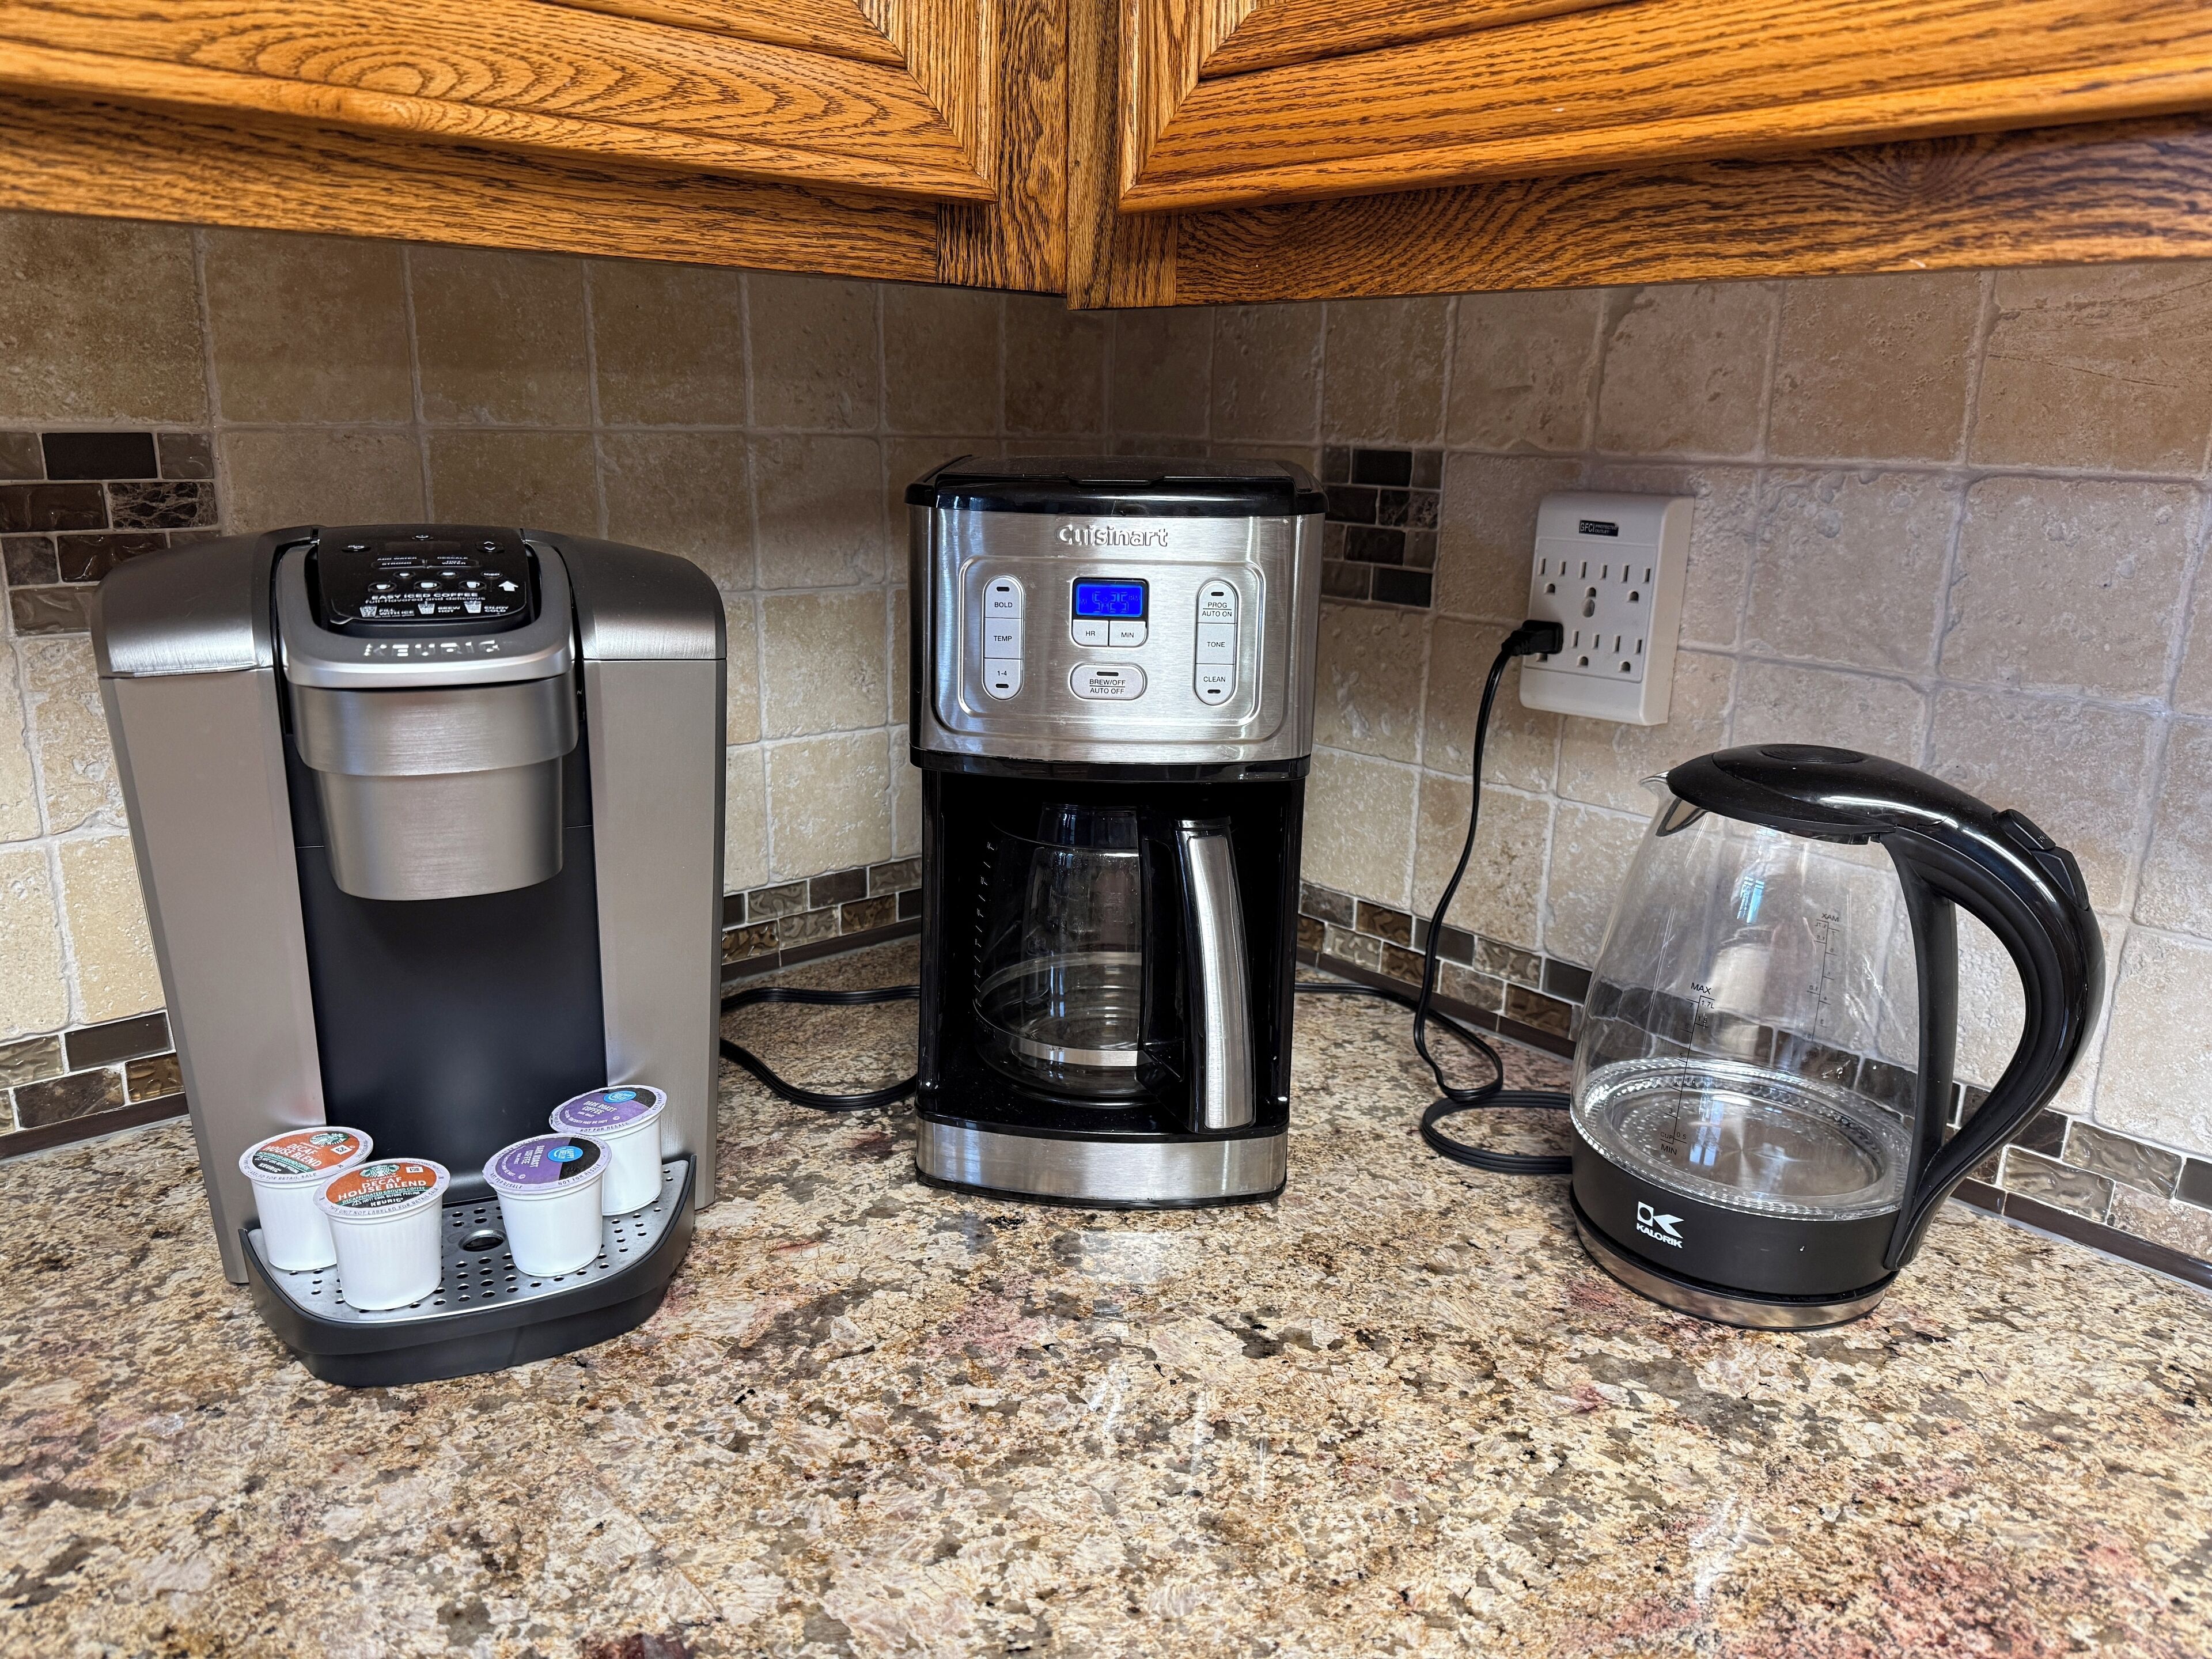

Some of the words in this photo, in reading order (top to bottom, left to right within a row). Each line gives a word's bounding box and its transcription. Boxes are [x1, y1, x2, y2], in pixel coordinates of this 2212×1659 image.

[1580, 522, 1594, 532] GFCI
[1055, 524, 1168, 547] Cuisinart
[364, 639, 500, 657] KEURIG
[1691, 982, 1711, 994] MAX
[1702, 1000, 1714, 1009] 1.7L
[582, 1106, 604, 1115] COFFEE
[597, 1104, 617, 1112] ROAST
[1660, 1131, 1674, 1139] CUP
[286, 1143, 318, 1156] DECAF
[1661, 1143, 1677, 1155] MIN
[263, 1145, 295, 1157] HOUSE
[290, 1152, 322, 1167] BLEND
[521, 1150, 534, 1165] COFFEE
[258, 1162, 281, 1173] KEURIG
[585, 1164, 601, 1176] RESALE
[362, 1177, 402, 1188] DECAF
[338, 1185, 382, 1201] HOUSE
[385, 1180, 427, 1190] BLEND
[342, 1191, 382, 1204] DECAFFEINATED
[368, 1207, 396, 1215] LABELED
[411, 1194, 430, 1205] RETAIL
[429, 1187, 438, 1195] SALE
[370, 1198, 402, 1207] KEURIG
[1636, 1222, 1683, 1249] KALORIK
